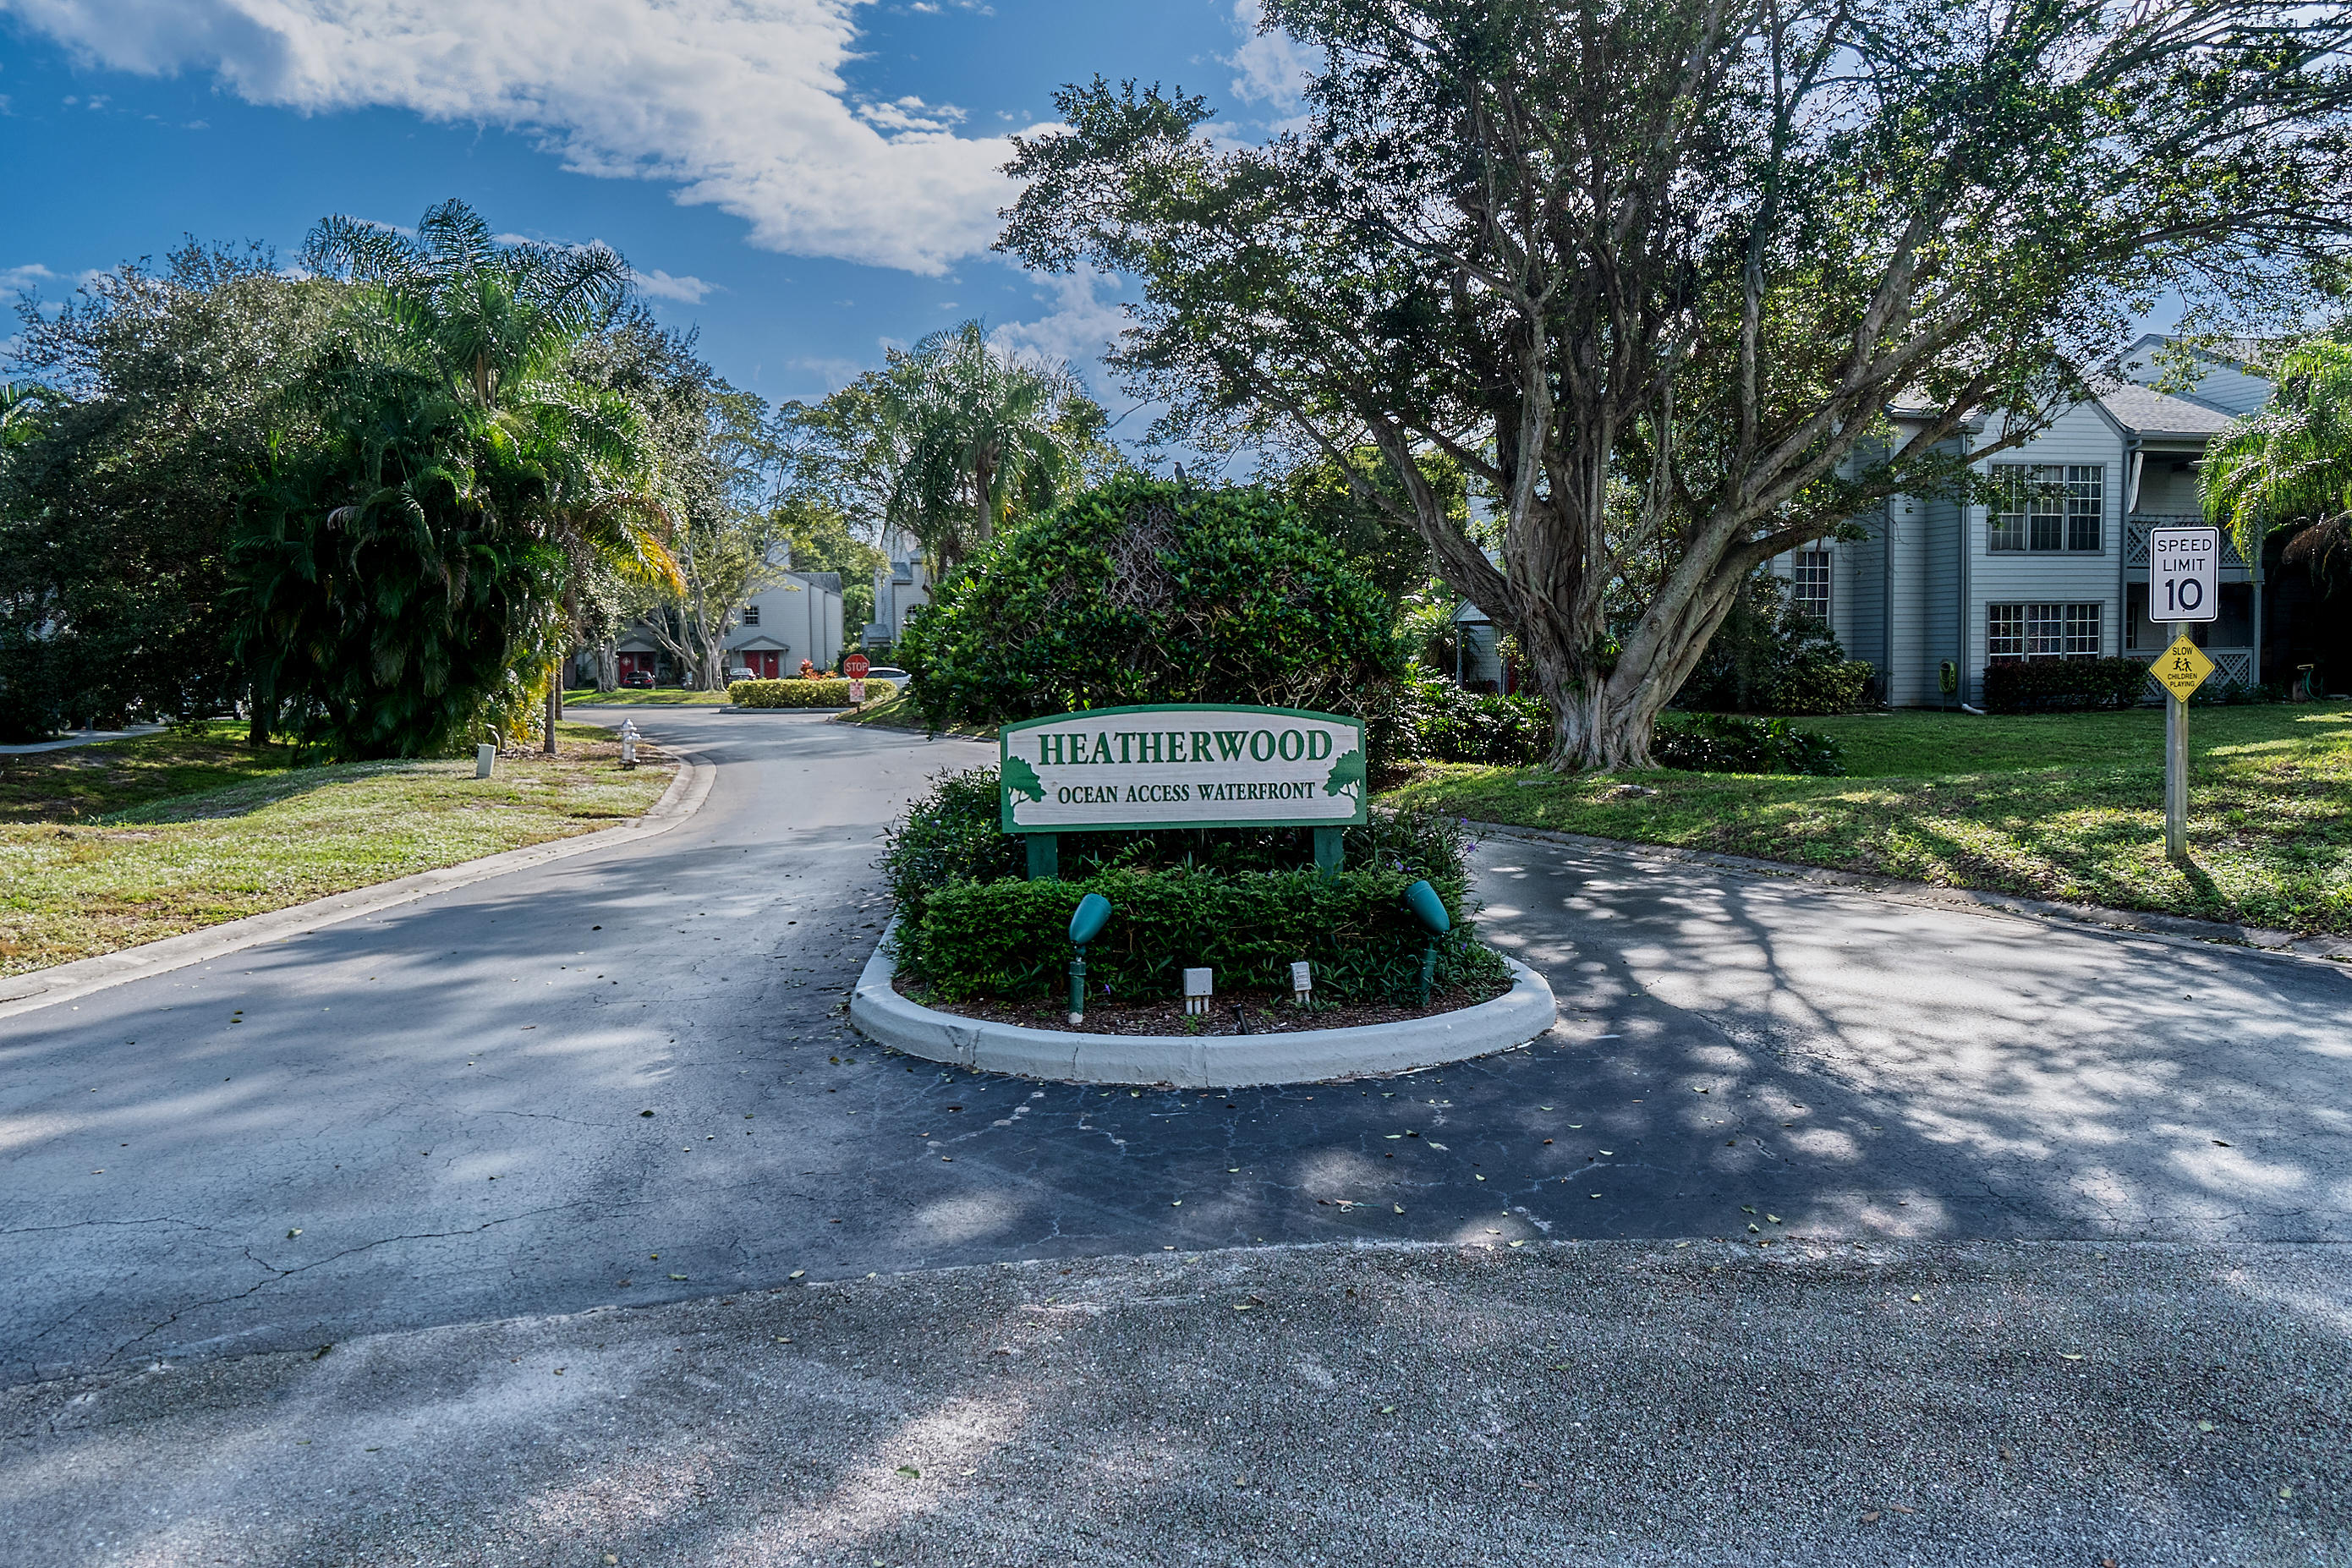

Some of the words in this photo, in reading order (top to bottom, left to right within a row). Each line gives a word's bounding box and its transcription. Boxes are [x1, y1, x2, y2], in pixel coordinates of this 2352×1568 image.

[2157, 539, 2212, 551] SPEED
[2163, 558, 2205, 571] LIMIT
[2165, 578, 2202, 611] 10
[2173, 647, 2193, 655] SLOW
[846, 662, 868, 672] STOP
[1038, 729, 1333, 765] HEATHERWOOD
[1058, 786, 1118, 804] OCEAN
[1125, 783, 1190, 803] ACCESS
[1197, 781, 1315, 801] WATERFRONT
